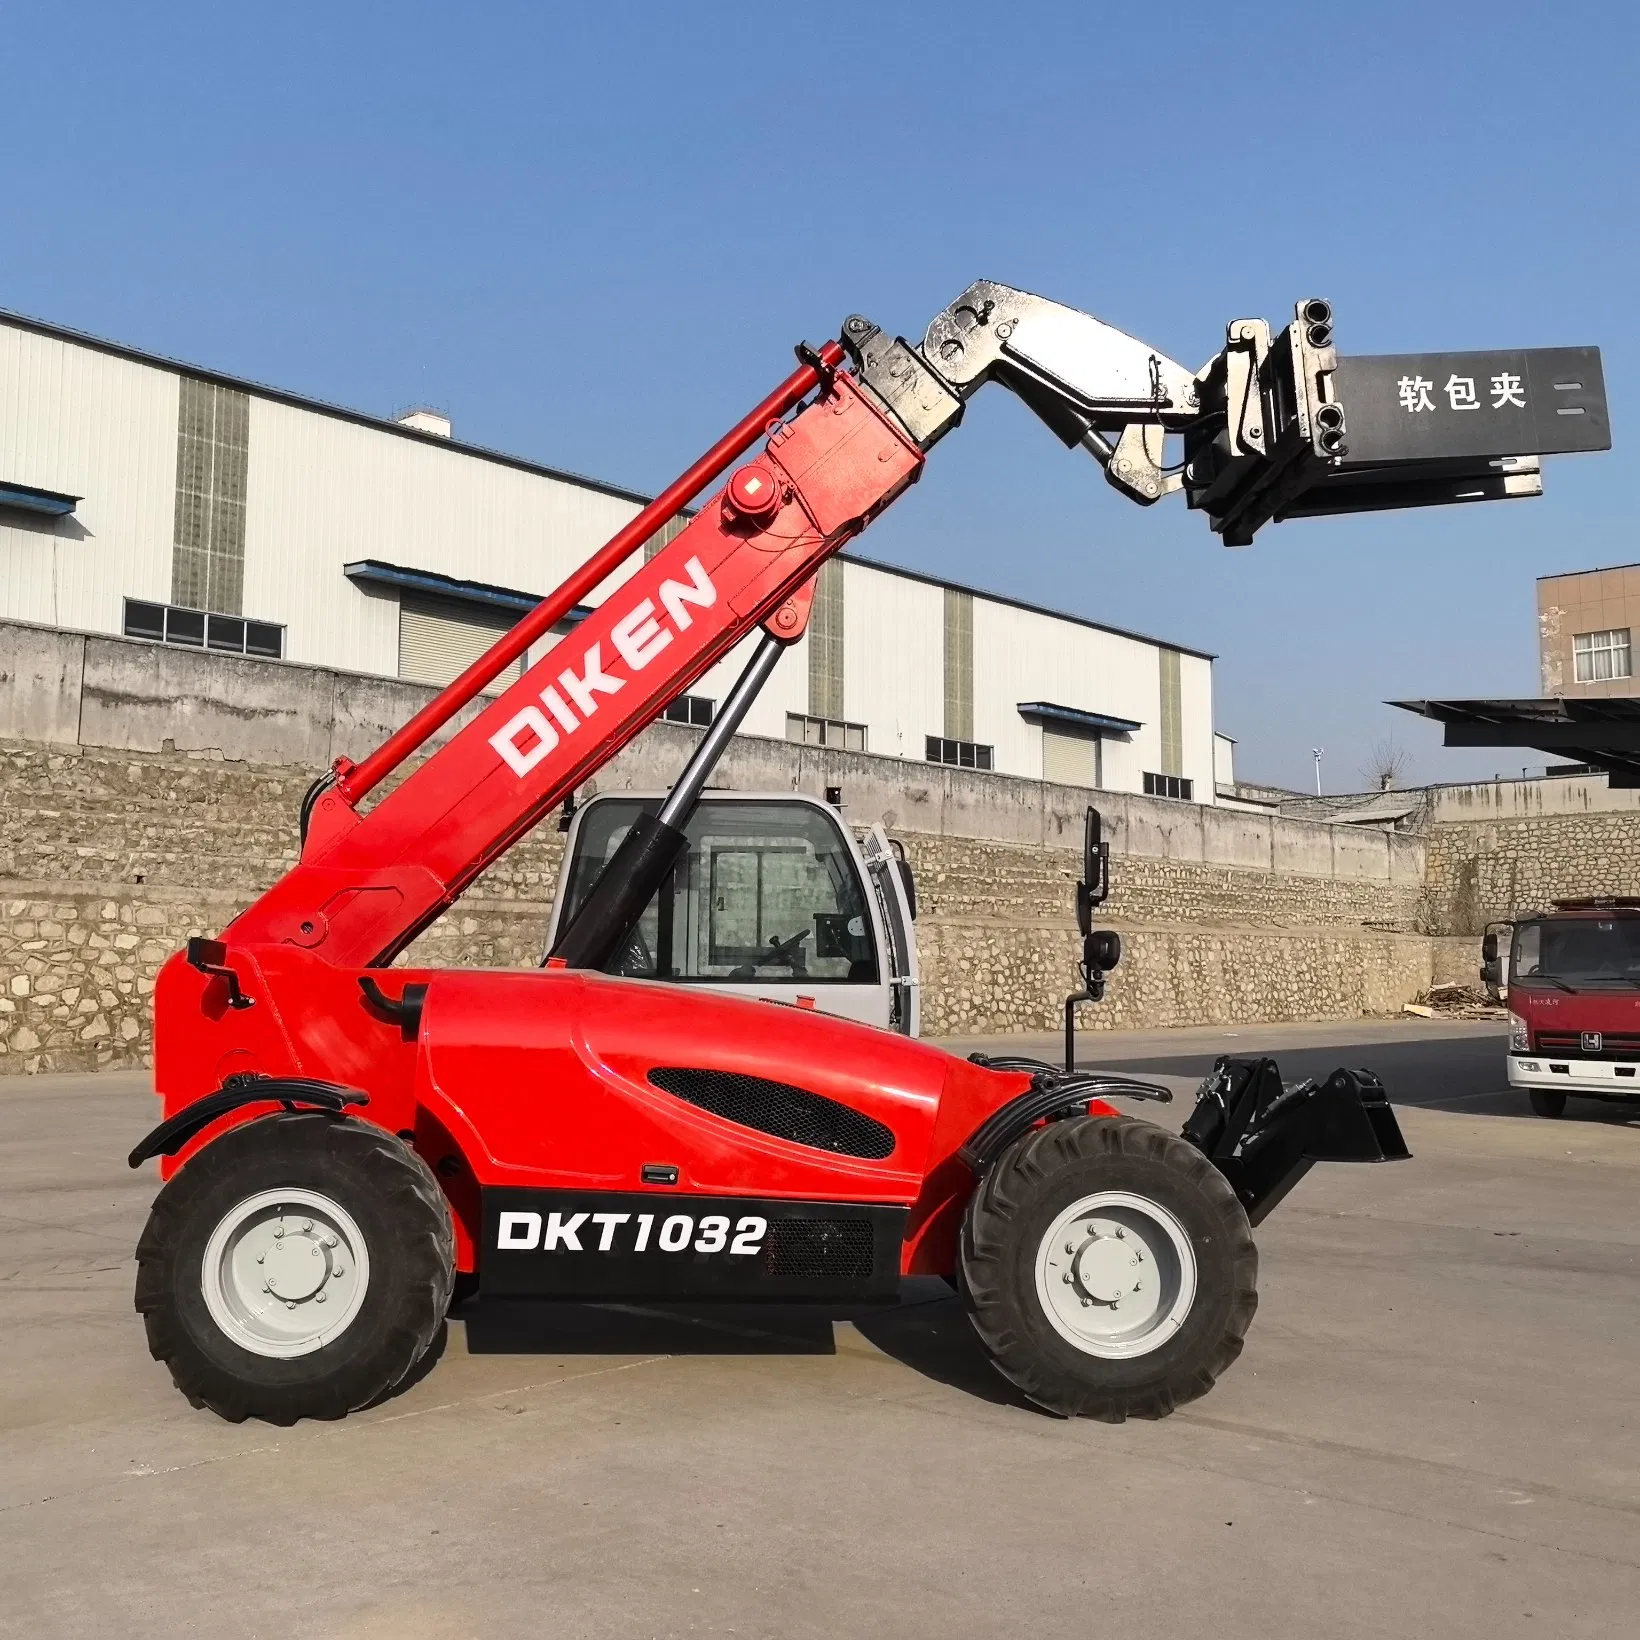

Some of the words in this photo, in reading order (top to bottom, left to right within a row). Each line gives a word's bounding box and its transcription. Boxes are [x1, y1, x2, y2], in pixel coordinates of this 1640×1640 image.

[1397, 372, 1527, 413] 软包夹
[488, 555, 717, 779] DIKEN
[497, 1211, 768, 1255] DKT1032
